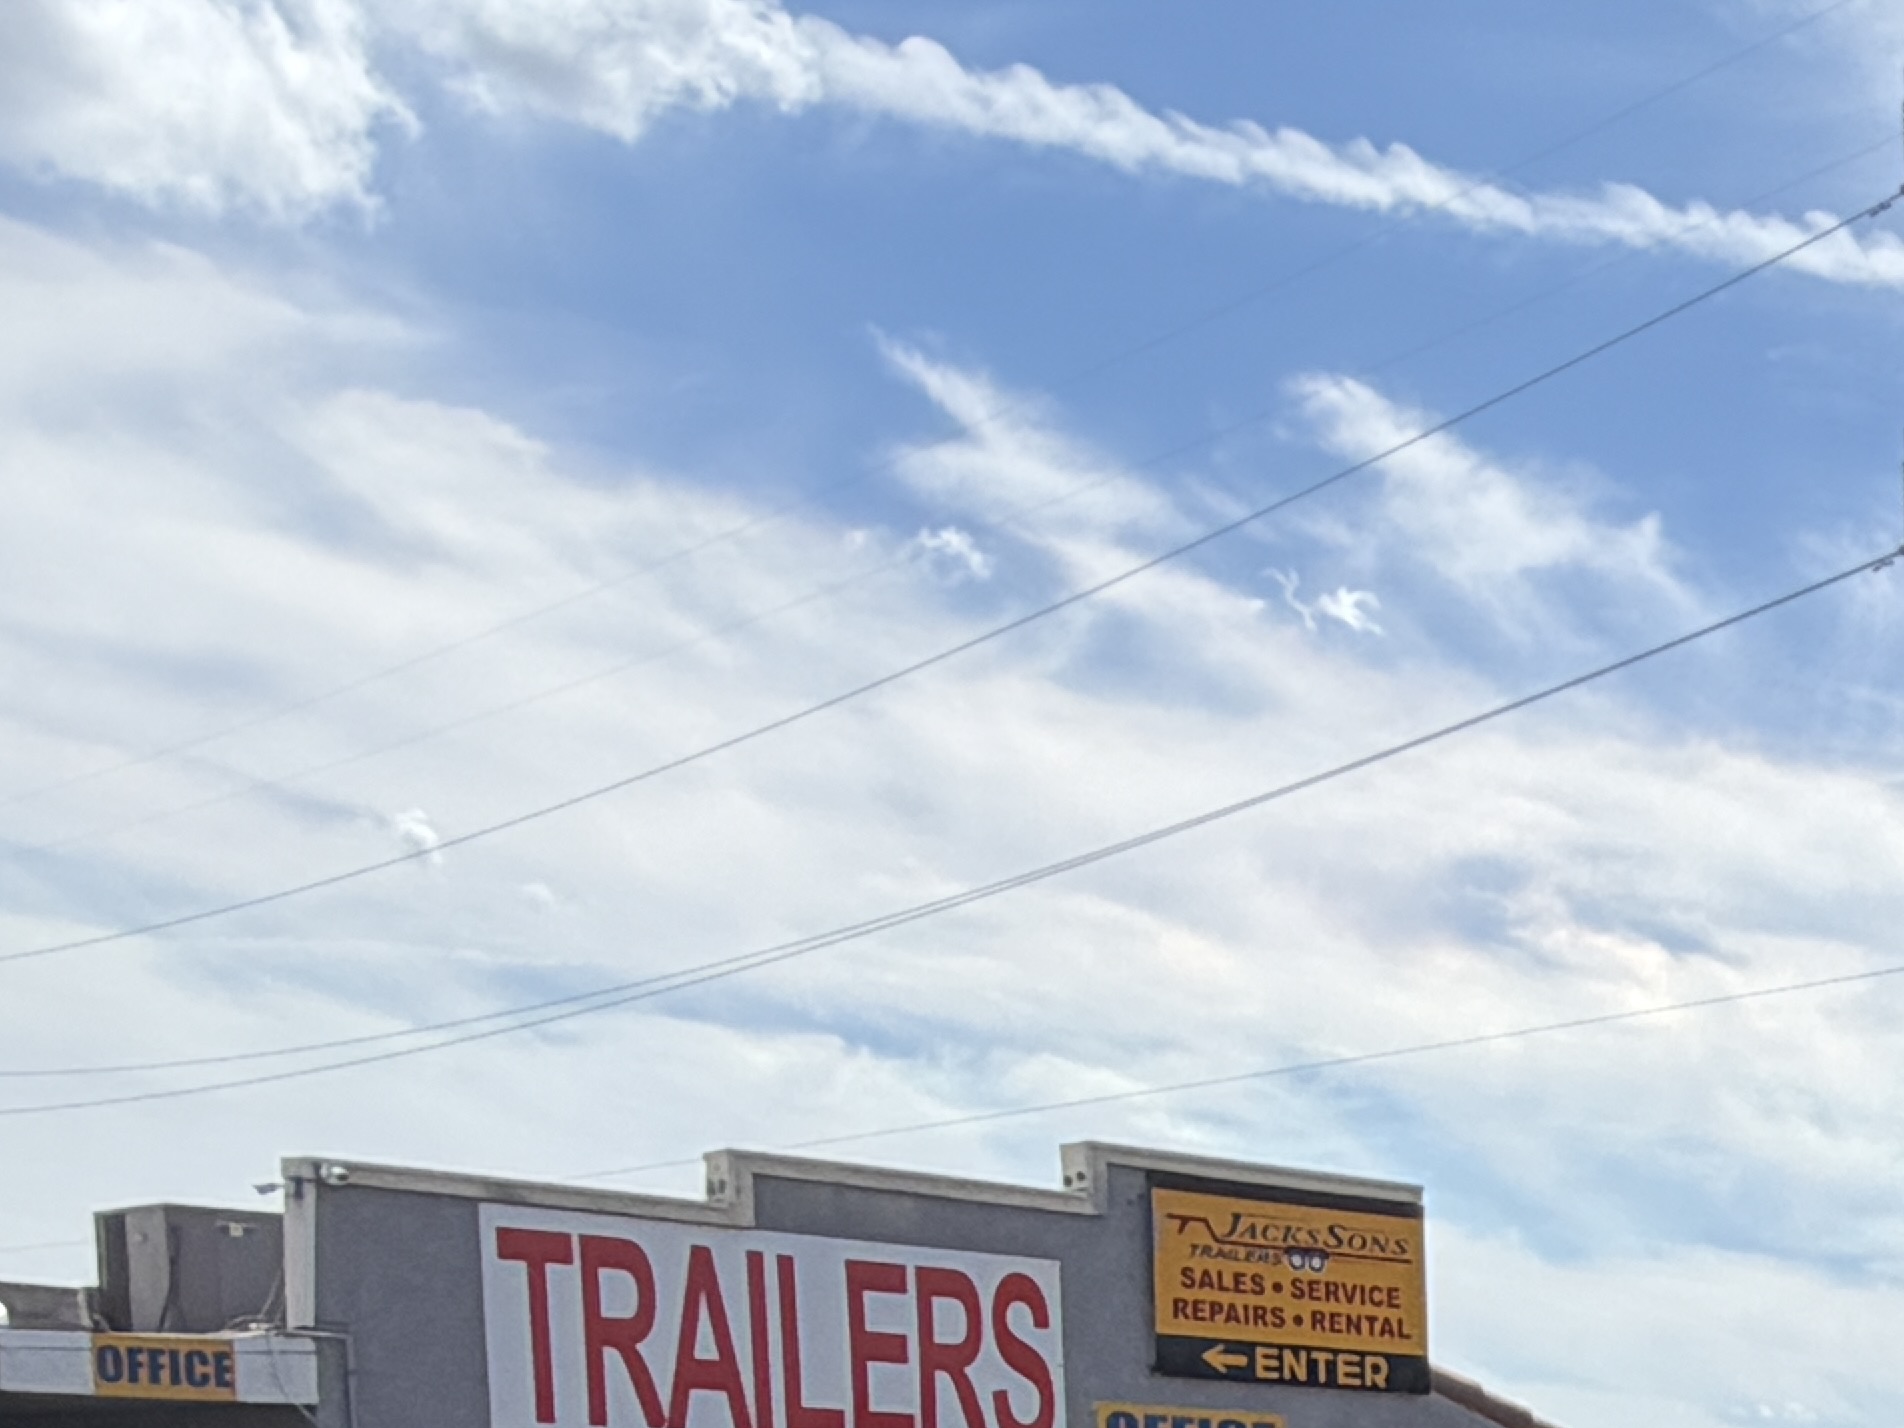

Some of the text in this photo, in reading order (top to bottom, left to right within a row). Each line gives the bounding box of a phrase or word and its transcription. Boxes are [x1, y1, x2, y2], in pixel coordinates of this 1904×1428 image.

[1189, 1244, 1282, 1266] TRAILERS
[1180, 1267, 1401, 1309] SALES SERVICE
[1172, 1298, 1412, 1340] REPAIRS RENTAL
[96, 1345, 233, 1387] OFFICE
[1254, 1346, 1390, 1389] ENTER
